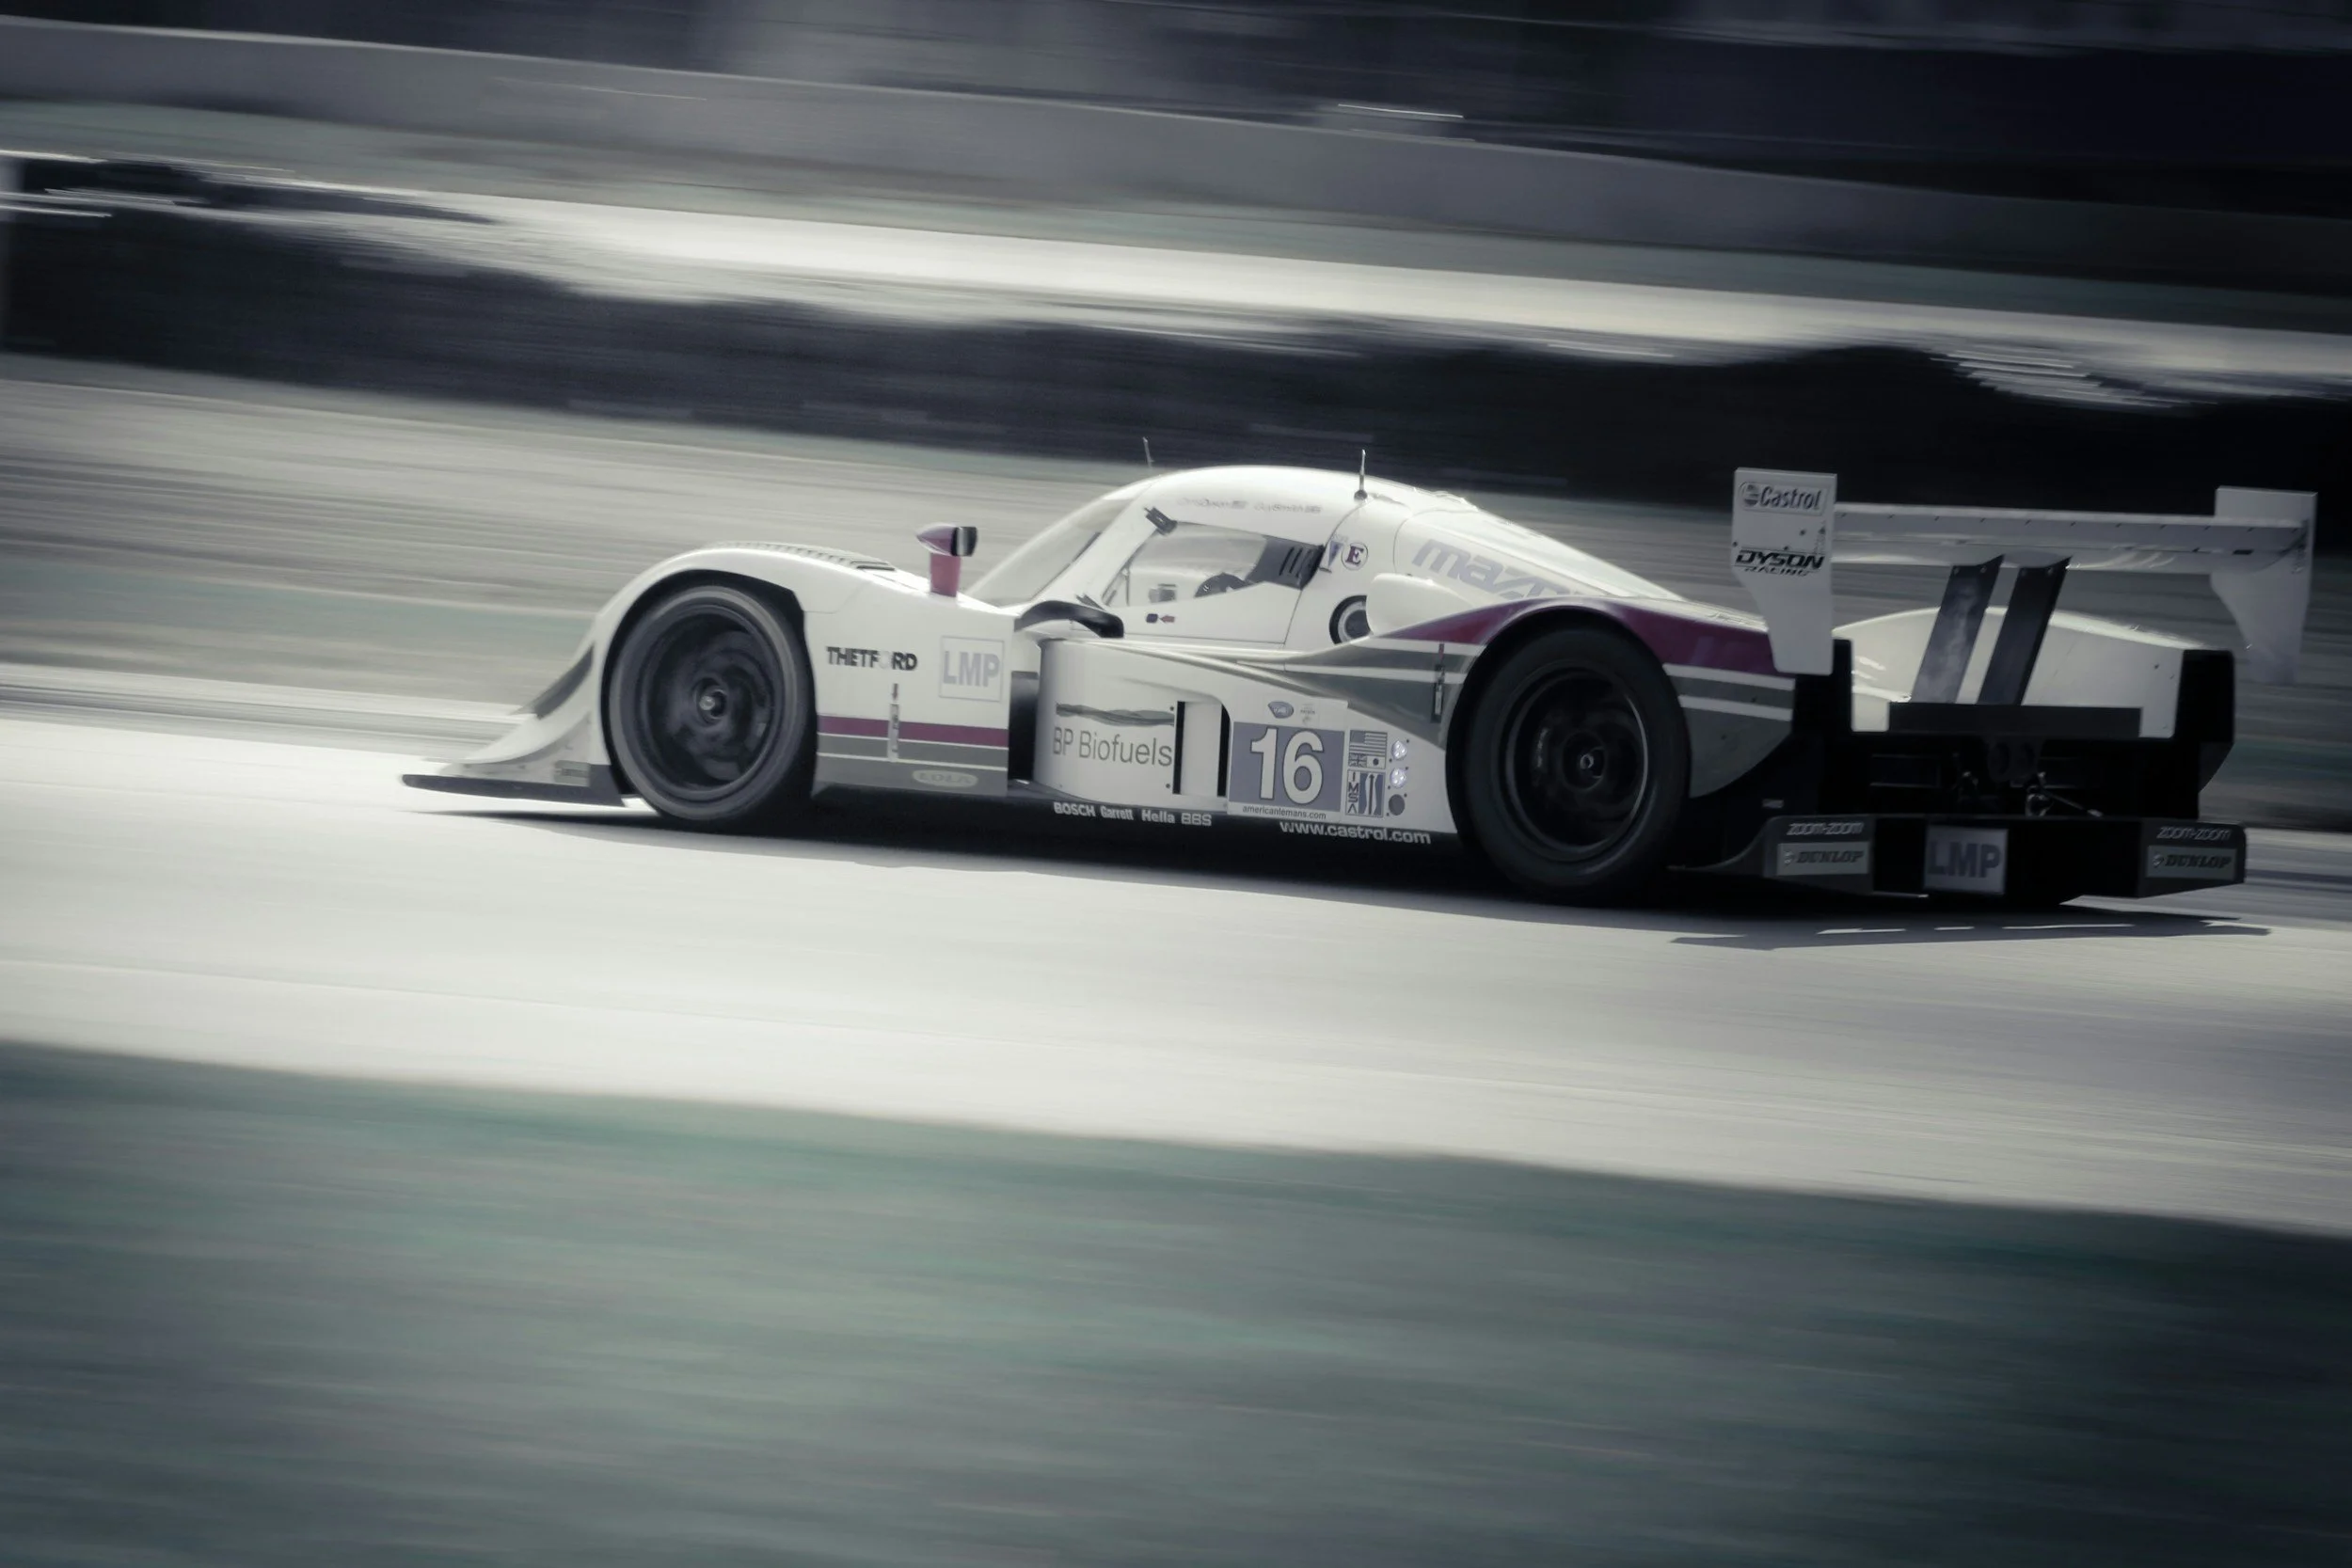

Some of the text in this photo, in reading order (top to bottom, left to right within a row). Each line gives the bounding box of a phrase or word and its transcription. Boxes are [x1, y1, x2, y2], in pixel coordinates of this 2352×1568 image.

[1760, 485, 1821, 510] Castrol
[1345, 546, 1364, 566] E
[1736, 550, 1825, 570] DYSON
[1412, 539, 1582, 599] maz
[1745, 566, 1811, 577] RACING
[943, 651, 1000, 688] LMP
[1053, 726, 1172, 767] BP Biofuels
[1250, 726, 1325, 805] 16
[1054, 801, 1212, 826] BOSCH Garrett Hella BBS
[1242, 804, 1327, 820] americanlemans.com
[1279, 821, 1431, 845] www.castrol.com
[1796, 850, 1865, 863] DUNLOP
[1929, 842, 2001, 879] LMP
[2164, 853, 2233, 868] DUNLOP
